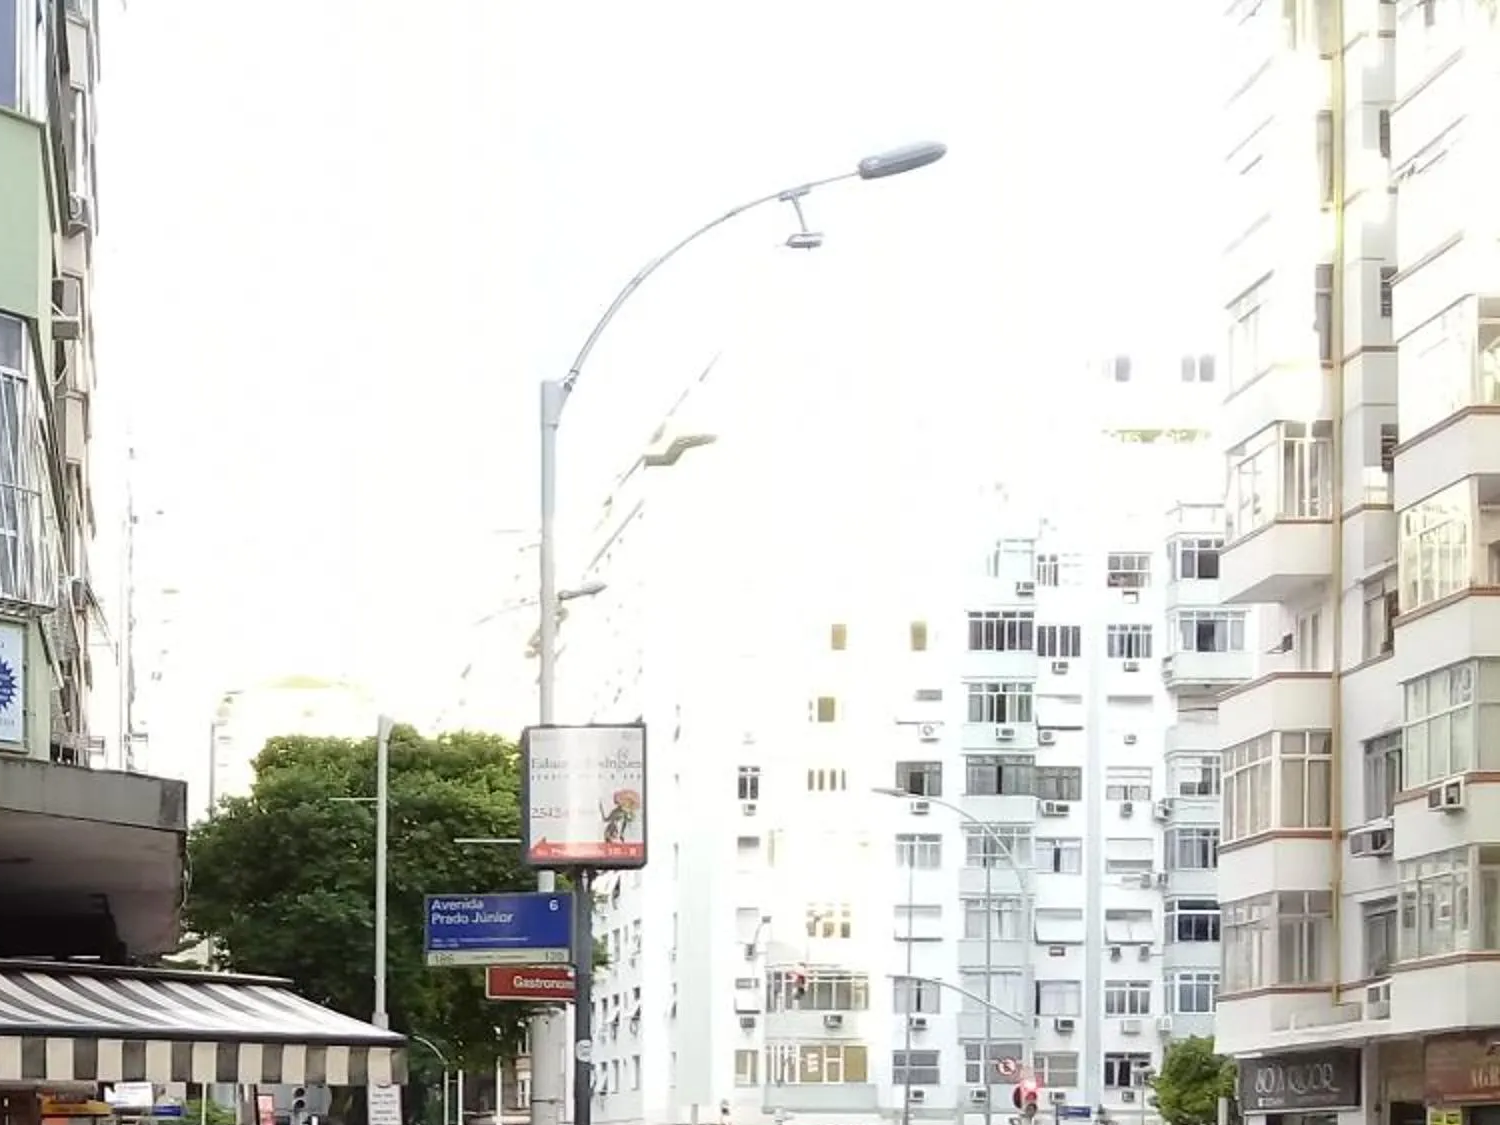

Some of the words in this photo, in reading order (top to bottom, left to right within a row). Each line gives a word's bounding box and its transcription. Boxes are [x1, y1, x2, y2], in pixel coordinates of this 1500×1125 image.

[431, 898, 484, 911] Avenida
[548, 900, 559, 911] 6
[431, 912, 469, 925] Prado
[471, 910, 514, 924] Júnior
